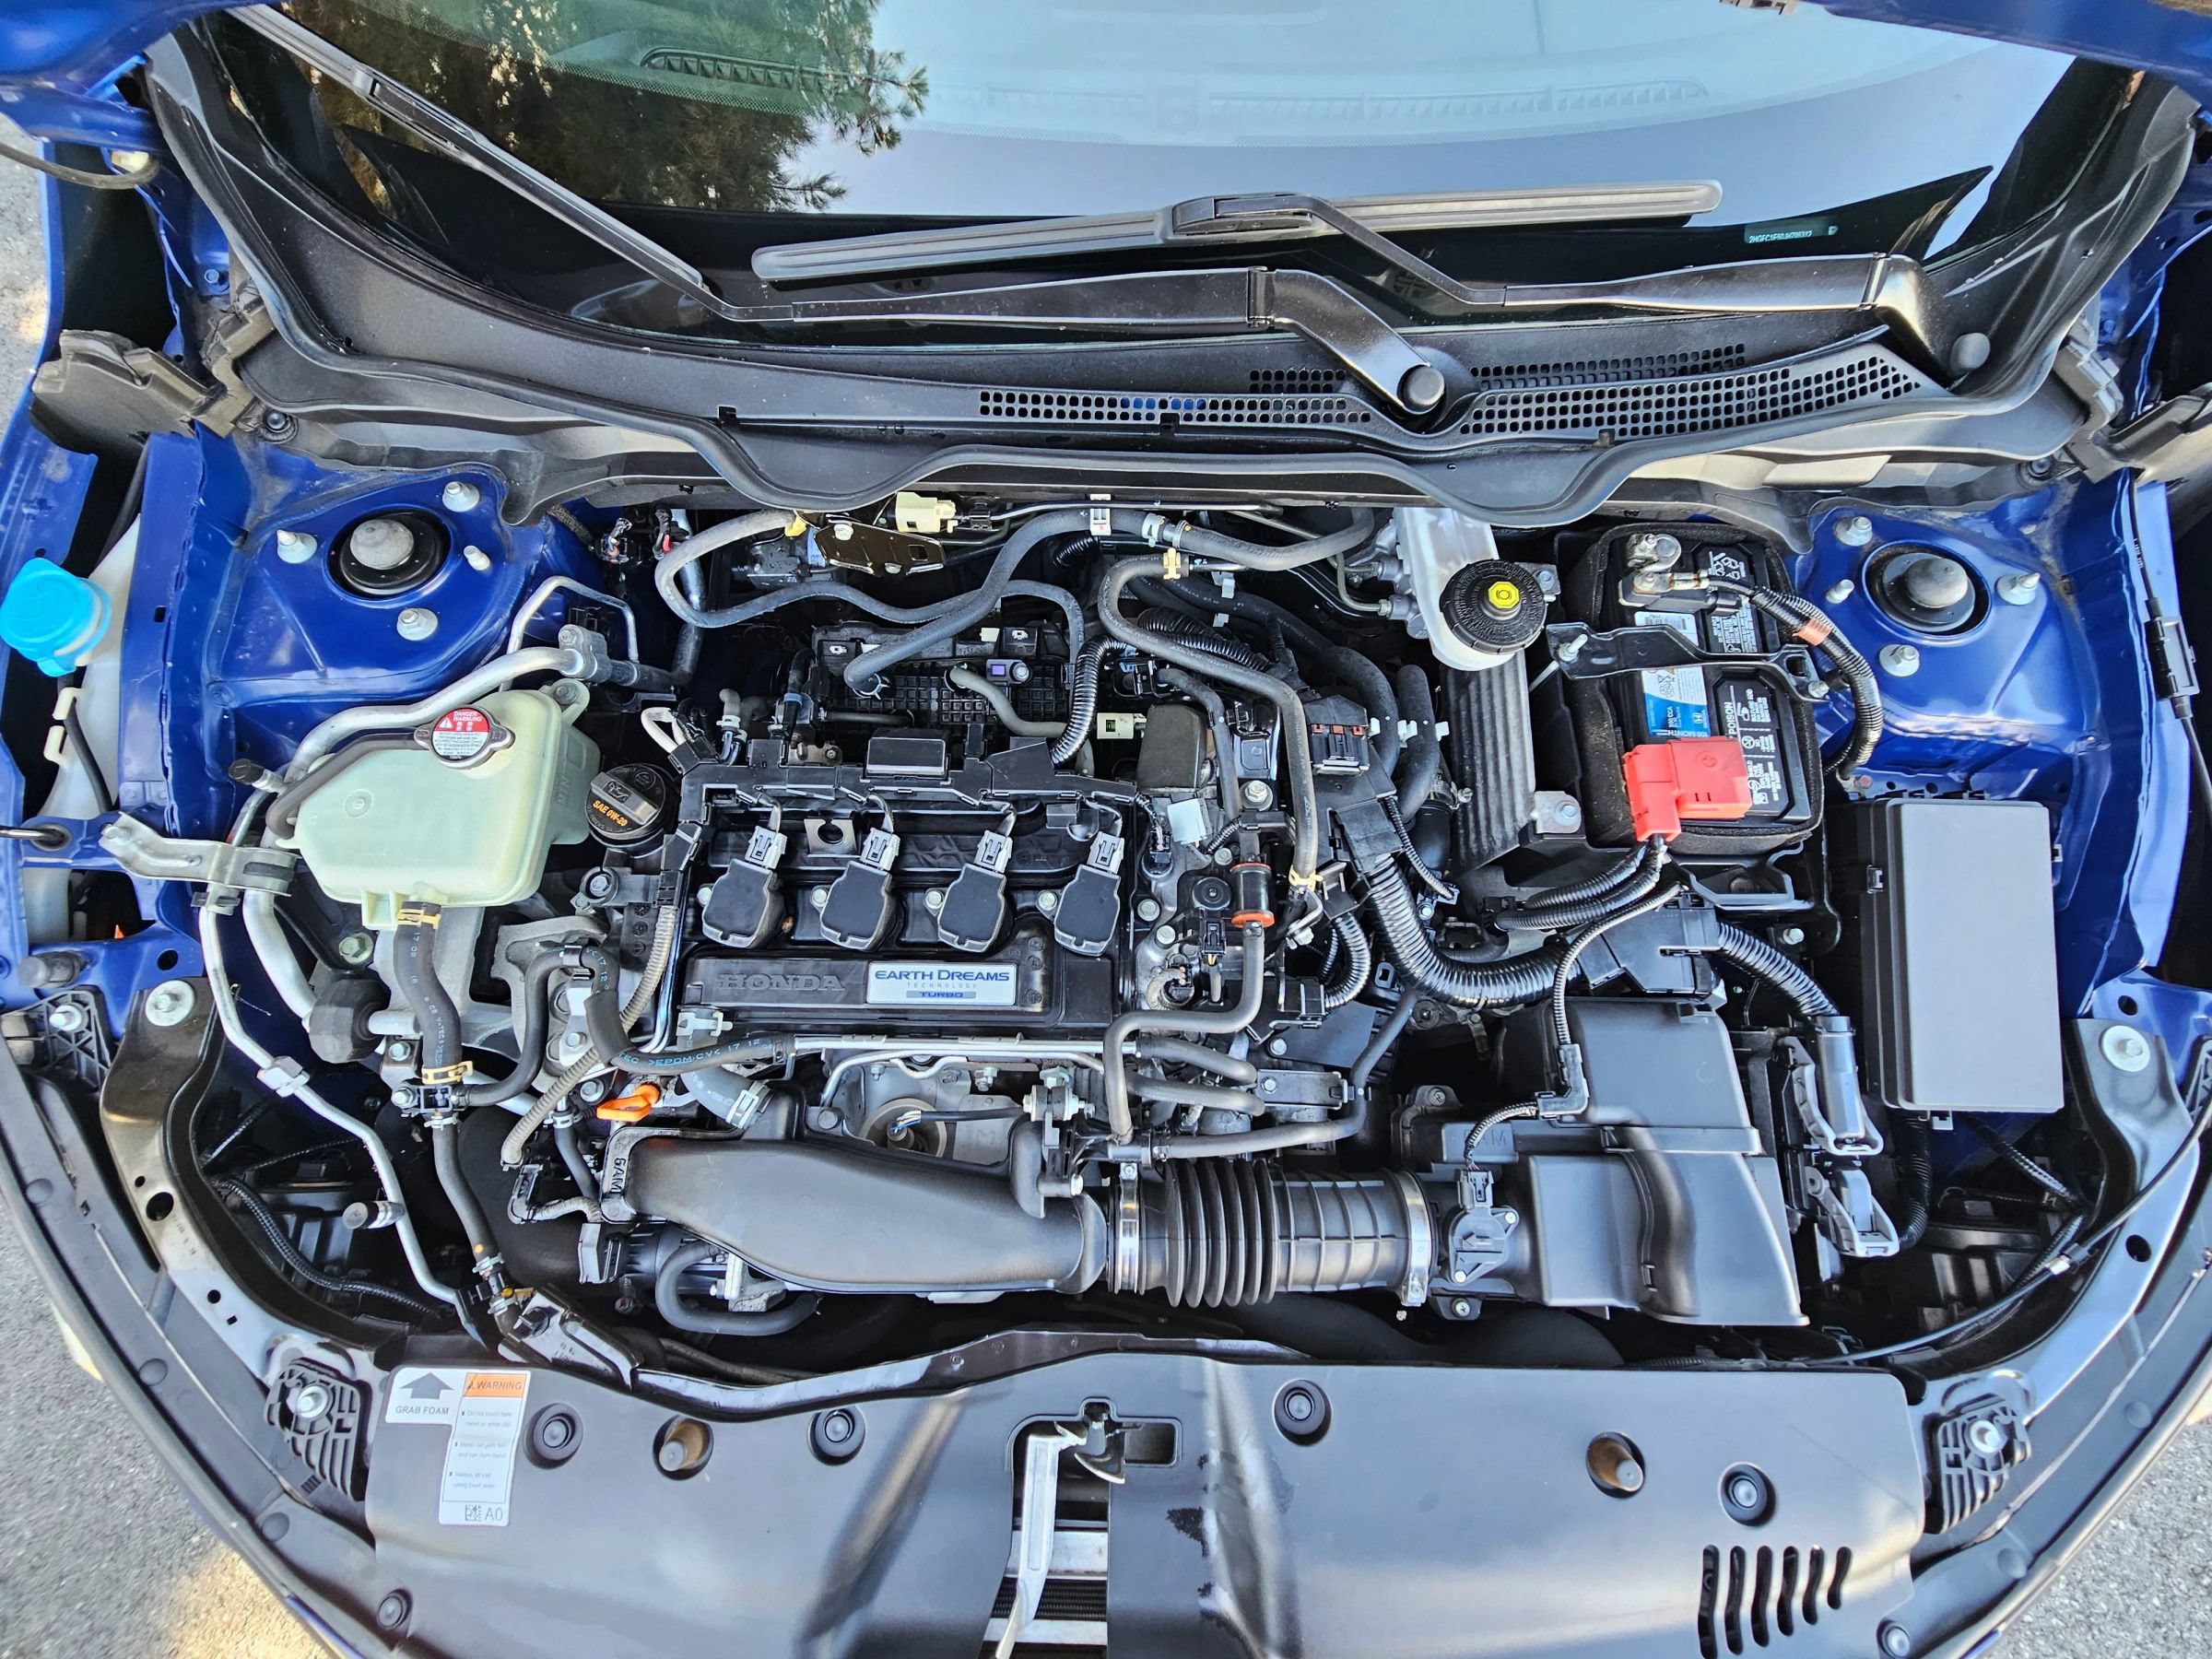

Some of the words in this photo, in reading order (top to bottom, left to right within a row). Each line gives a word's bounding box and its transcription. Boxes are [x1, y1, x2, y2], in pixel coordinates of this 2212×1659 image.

[1724, 701, 1737, 735] POISON
[593, 800, 609, 814] SAE
[719, 973, 845, 991] HONDA
[875, 971, 933, 982] EARTH
[937, 970, 1010, 982] DREAMS
[919, 991, 964, 999] TURBO
[728, 1042, 740, 1053] 17
[477, 1379, 523, 1391] WARNING
[395, 1406, 421, 1414] GRAB
[423, 1406, 450, 1415] FOAM
[485, 1507, 503, 1522] A0
